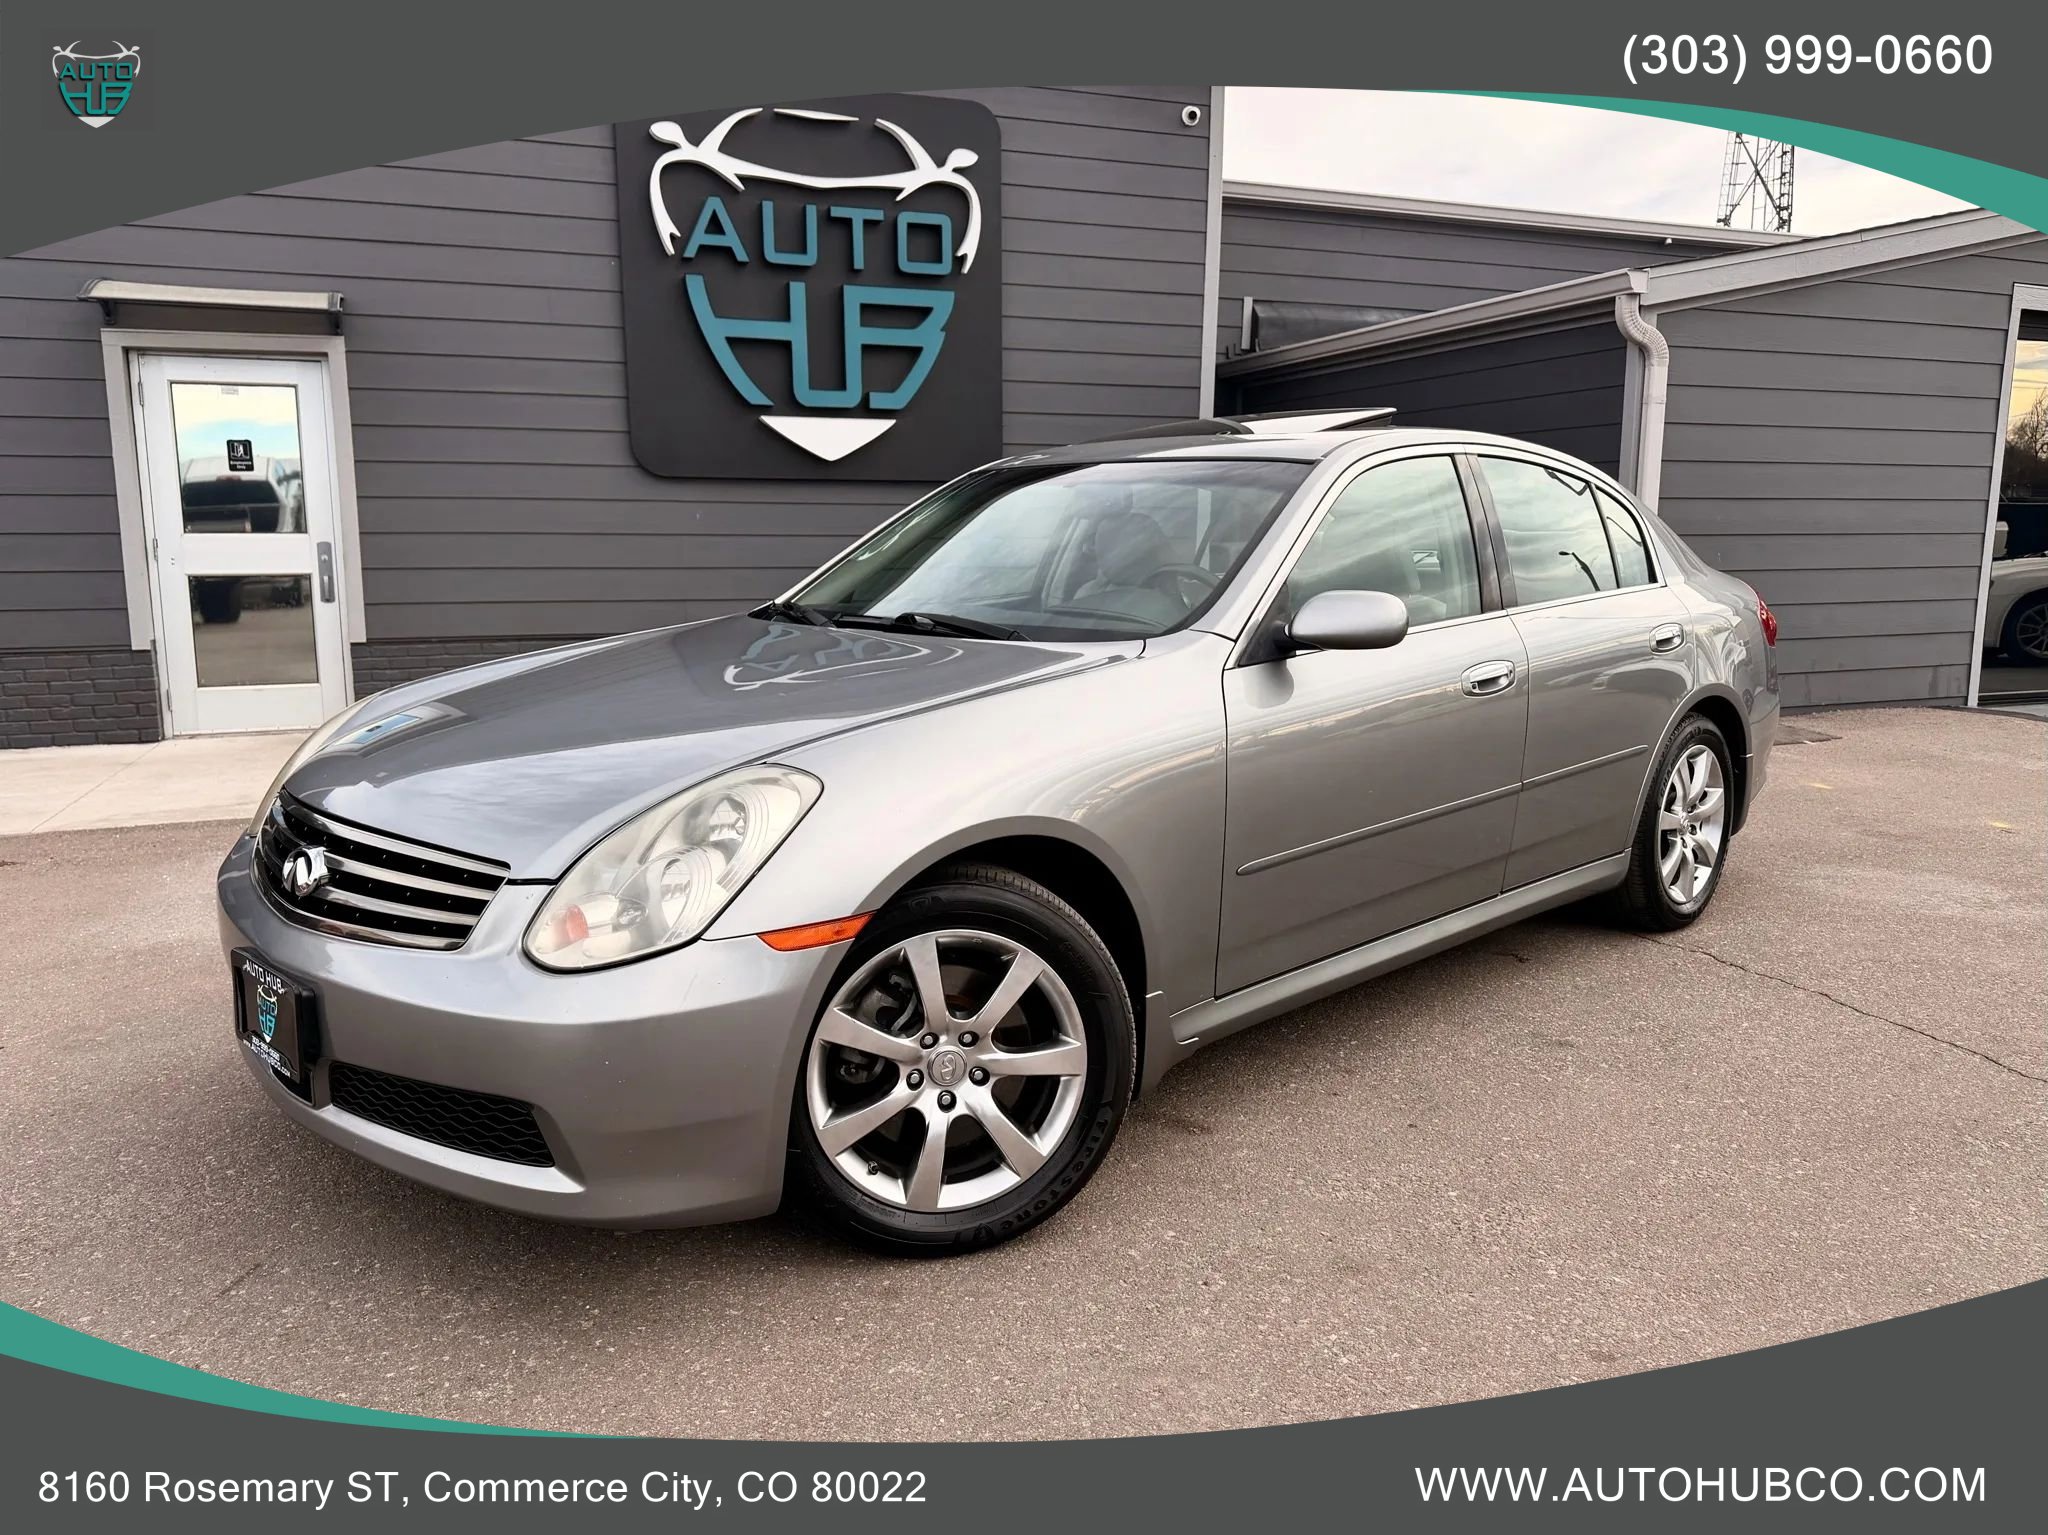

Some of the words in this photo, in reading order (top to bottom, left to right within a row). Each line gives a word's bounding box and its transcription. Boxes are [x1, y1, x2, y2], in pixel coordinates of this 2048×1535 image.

[682, 196, 953, 276] AUTO
[685, 274, 955, 411] HUB
[245, 959, 265, 983] AUTO
[265, 971, 283, 994] HUB
